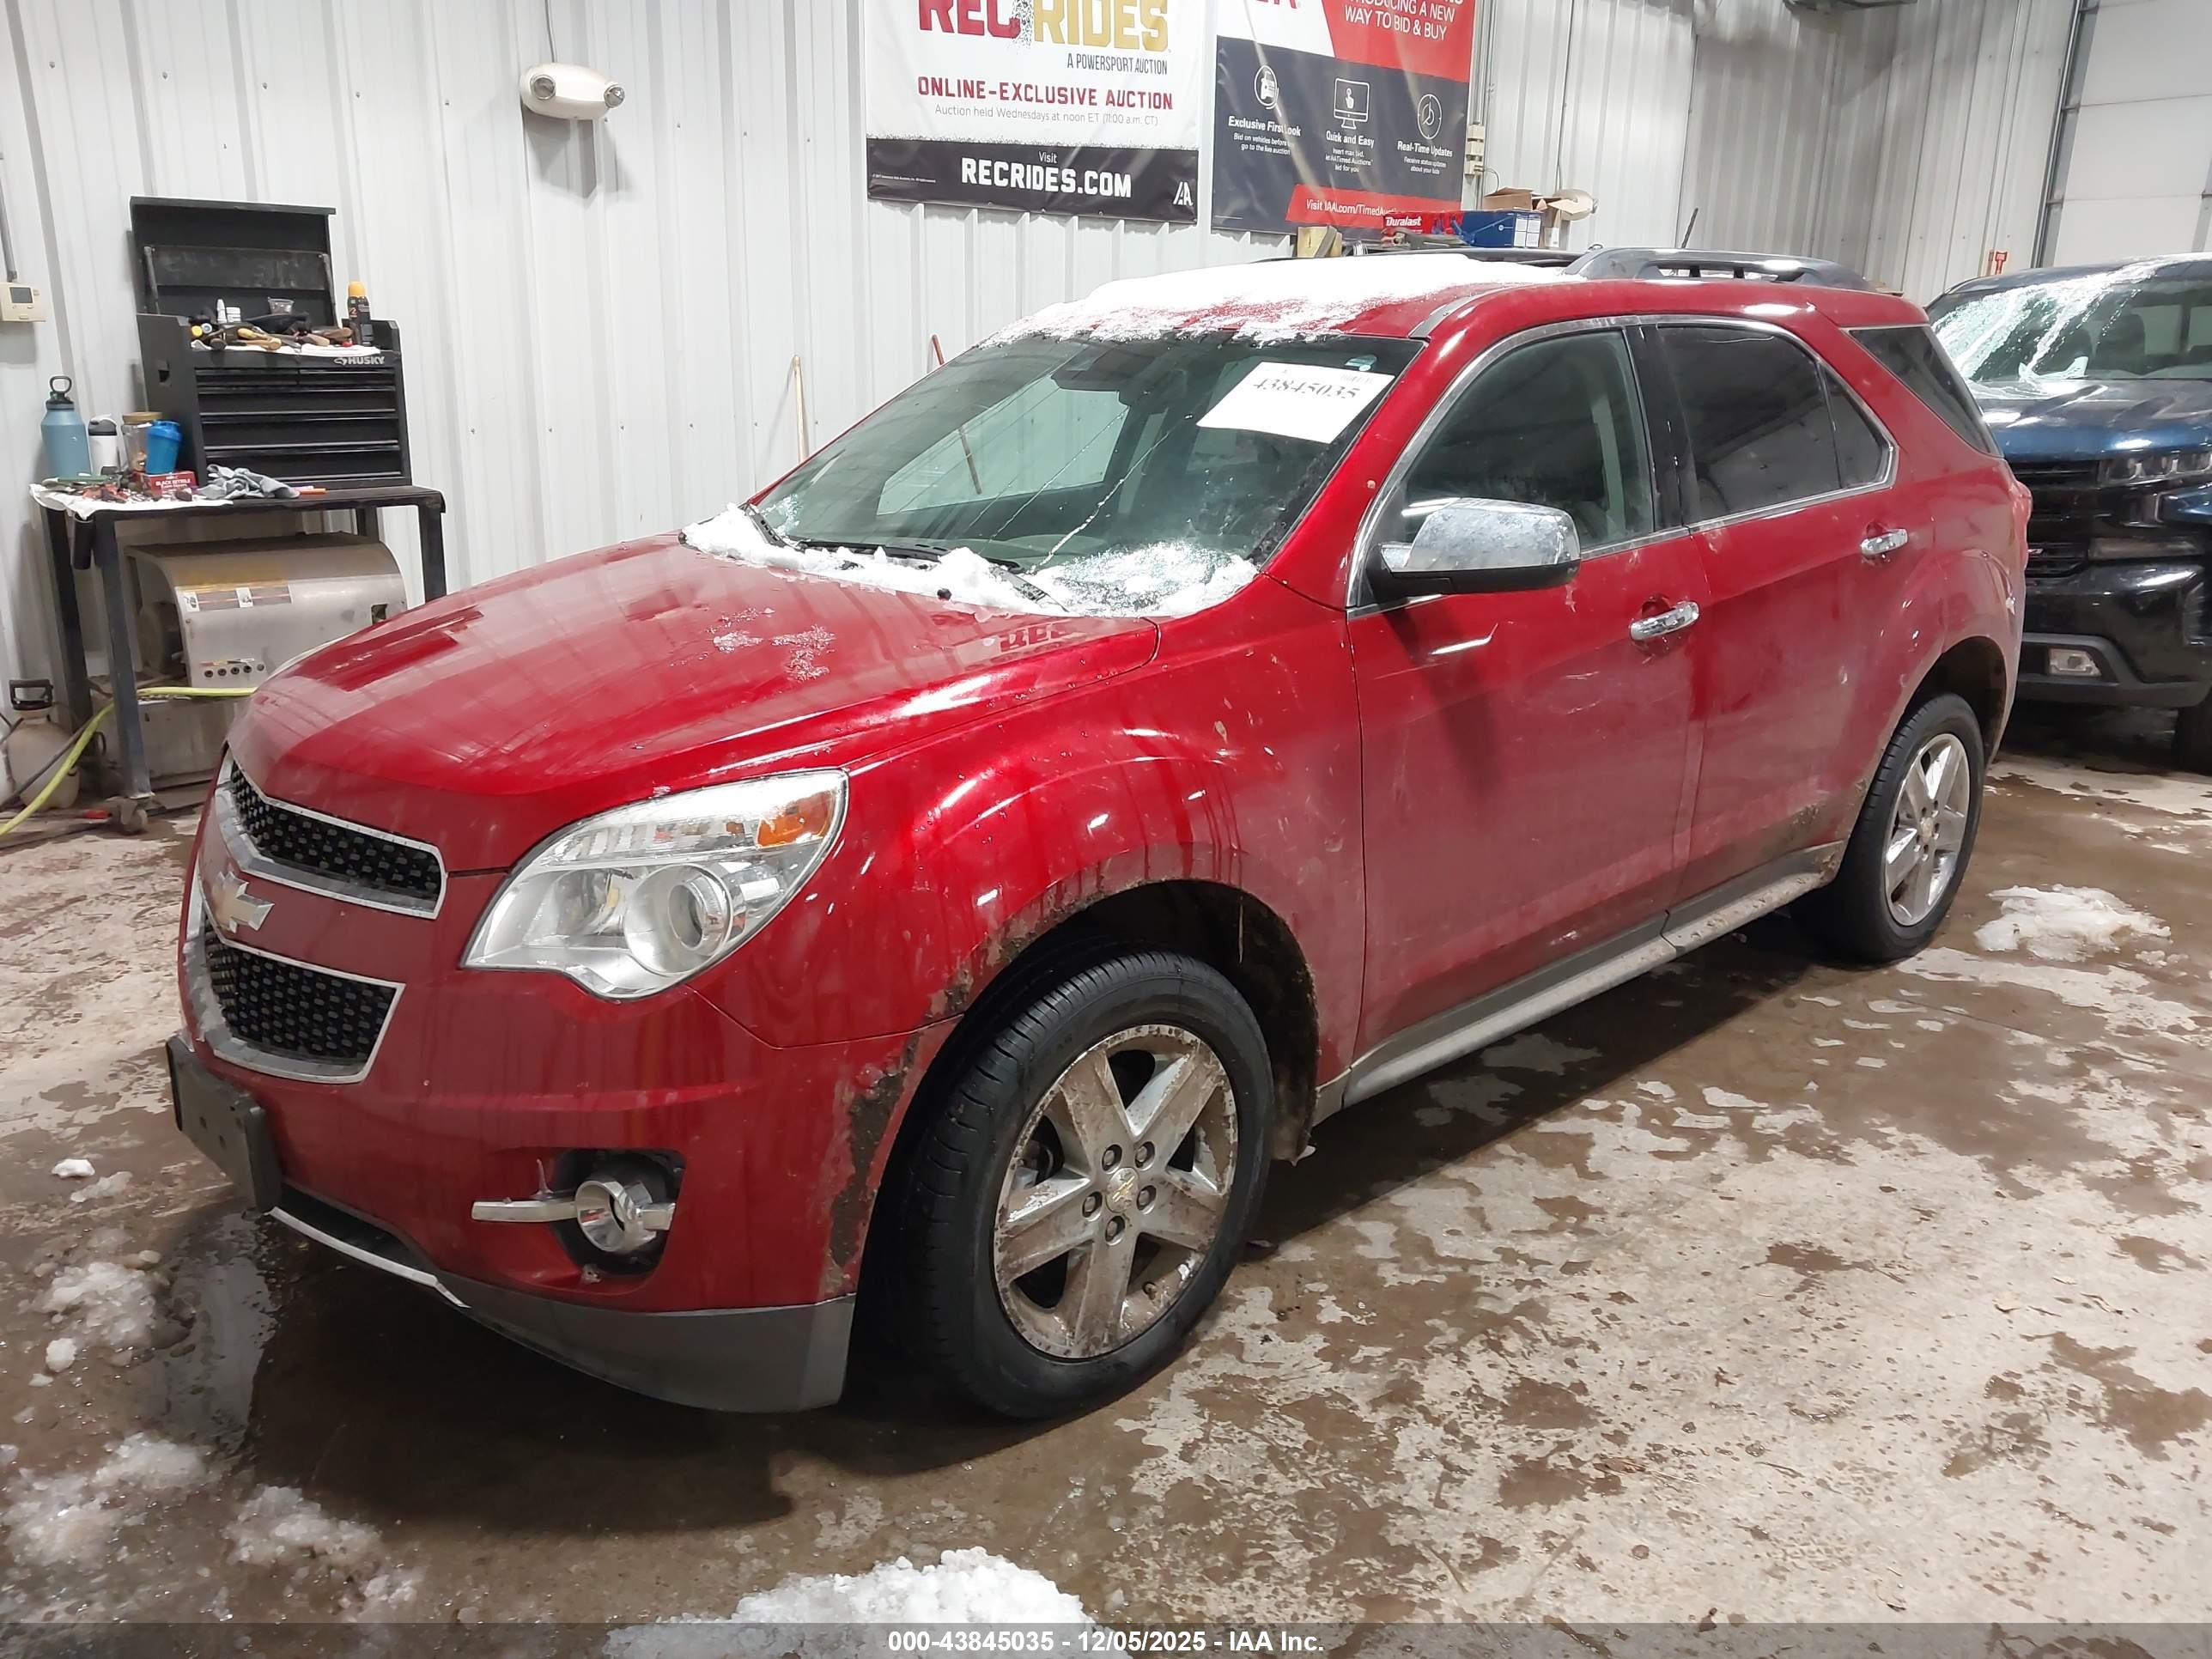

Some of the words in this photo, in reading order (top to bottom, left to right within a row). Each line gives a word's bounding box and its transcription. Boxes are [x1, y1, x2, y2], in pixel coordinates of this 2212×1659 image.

[1419, 2, 1426, 16] A
[1430, 3, 1455, 22] NEW
[1345, 5, 1372, 25] WAY
[1375, 10, 1391, 28] TO
[1395, 15, 1411, 33] BID
[1413, 19, 1421, 35] &
[1425, 22, 1447, 40] BUY
[1067, 52, 1073, 69] A
[1076, 53, 1133, 72] POWERSPORT
[1134, 58, 1168, 75] AUCTION
[918, 76, 1098, 106] ONLINE-EXCLUSIVE
[1105, 89, 1174, 110] AUCTION
[935, 103, 971, 117] Auction
[974, 106, 994, 117] held
[996, 107, 1050, 122] Wednesdays
[1052, 112, 1060, 121] at
[1063, 113, 1085, 123] noon
[1088, 112, 1100, 123] ET
[1126, 115, 1143, 125] a.m.
[1145, 115, 1159, 126] CT)
[1228, 115, 1267, 131] Exclusive
[1233, 132, 1244, 141] Bid
[1326, 131, 1342, 142] Quick
[1343, 135, 1357, 145] and
[1358, 136, 1375, 149] Easy
[1037, 151, 1058, 164] Visit
[1397, 140, 1430, 155] Real-Time
[1431, 144, 1453, 158] Updates
[961, 157, 1132, 198] RECRIDES.COM
[1306, 198, 1323, 211] Visit
[1385, 215, 1422, 227] Duralast
[348, 356, 386, 365] HUSKY
